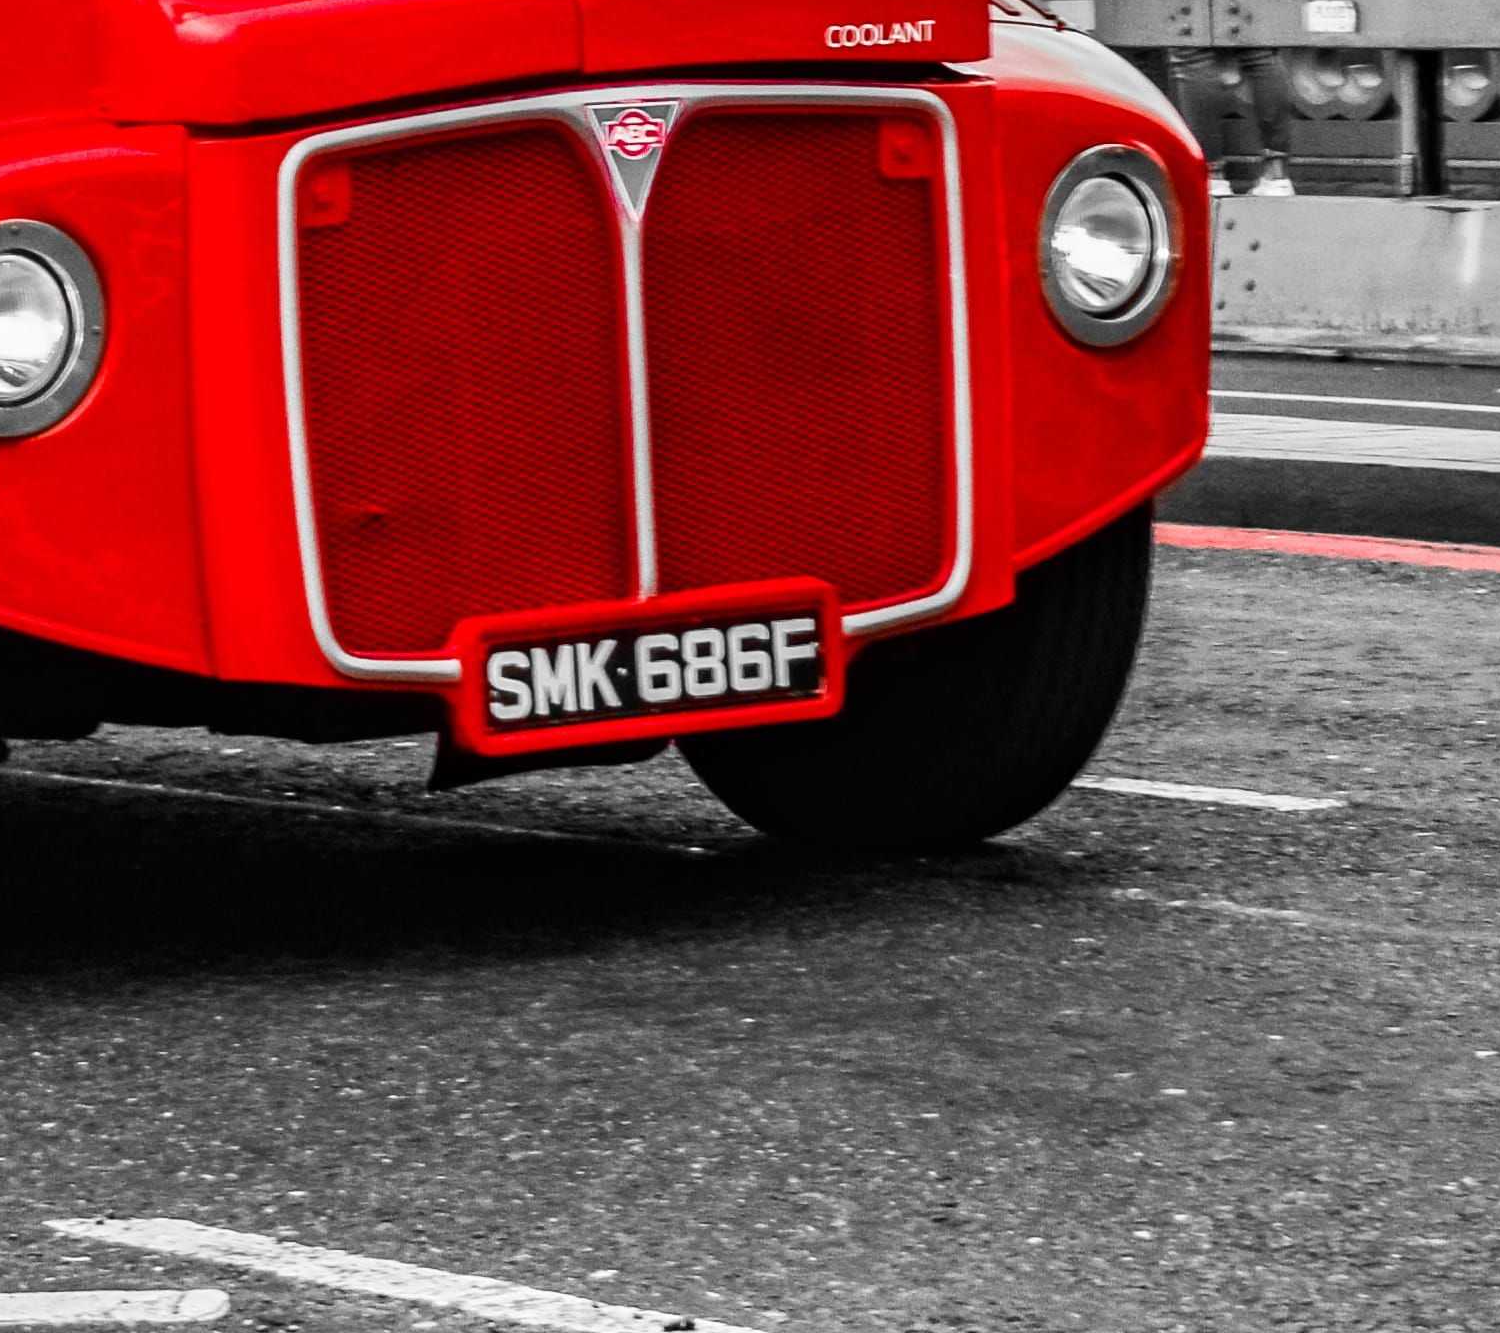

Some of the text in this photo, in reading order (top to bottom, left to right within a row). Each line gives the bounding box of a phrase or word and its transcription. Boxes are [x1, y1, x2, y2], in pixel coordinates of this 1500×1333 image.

[824, 19, 936, 48] COOLANT
[486, 617, 818, 721] SMK 686F
